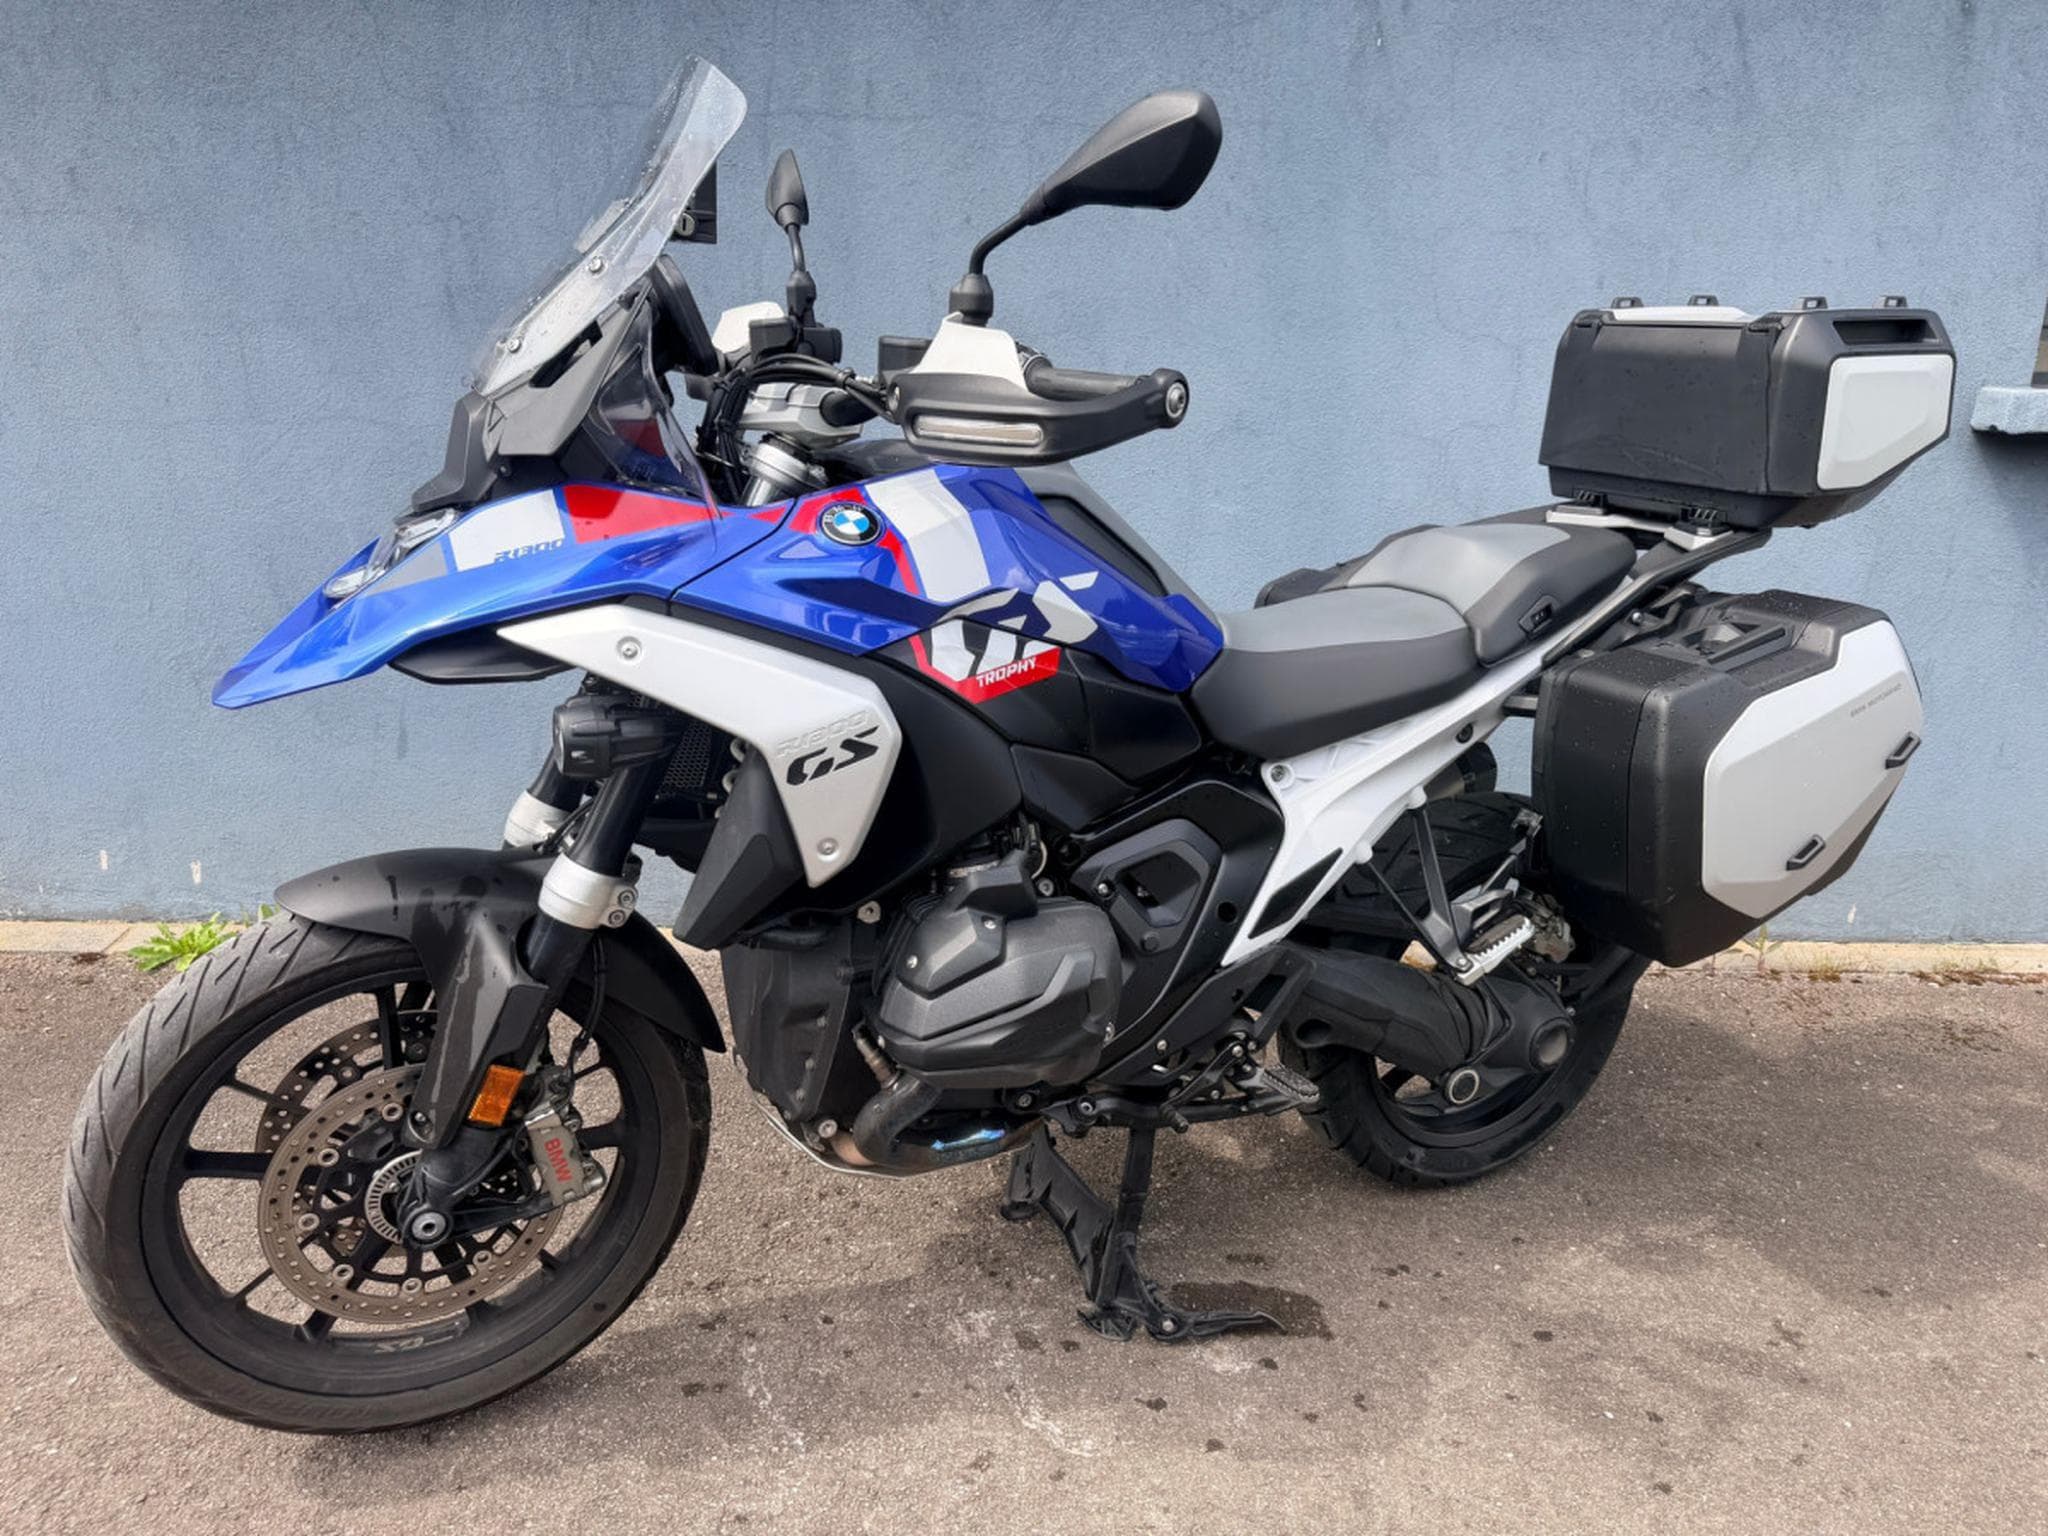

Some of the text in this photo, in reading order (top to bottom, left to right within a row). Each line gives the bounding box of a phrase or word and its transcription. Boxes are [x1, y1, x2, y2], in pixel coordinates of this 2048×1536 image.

[976, 656, 1036, 688] TROPHY
[786, 725, 880, 785] GS
[544, 1137, 573, 1183] BMW
